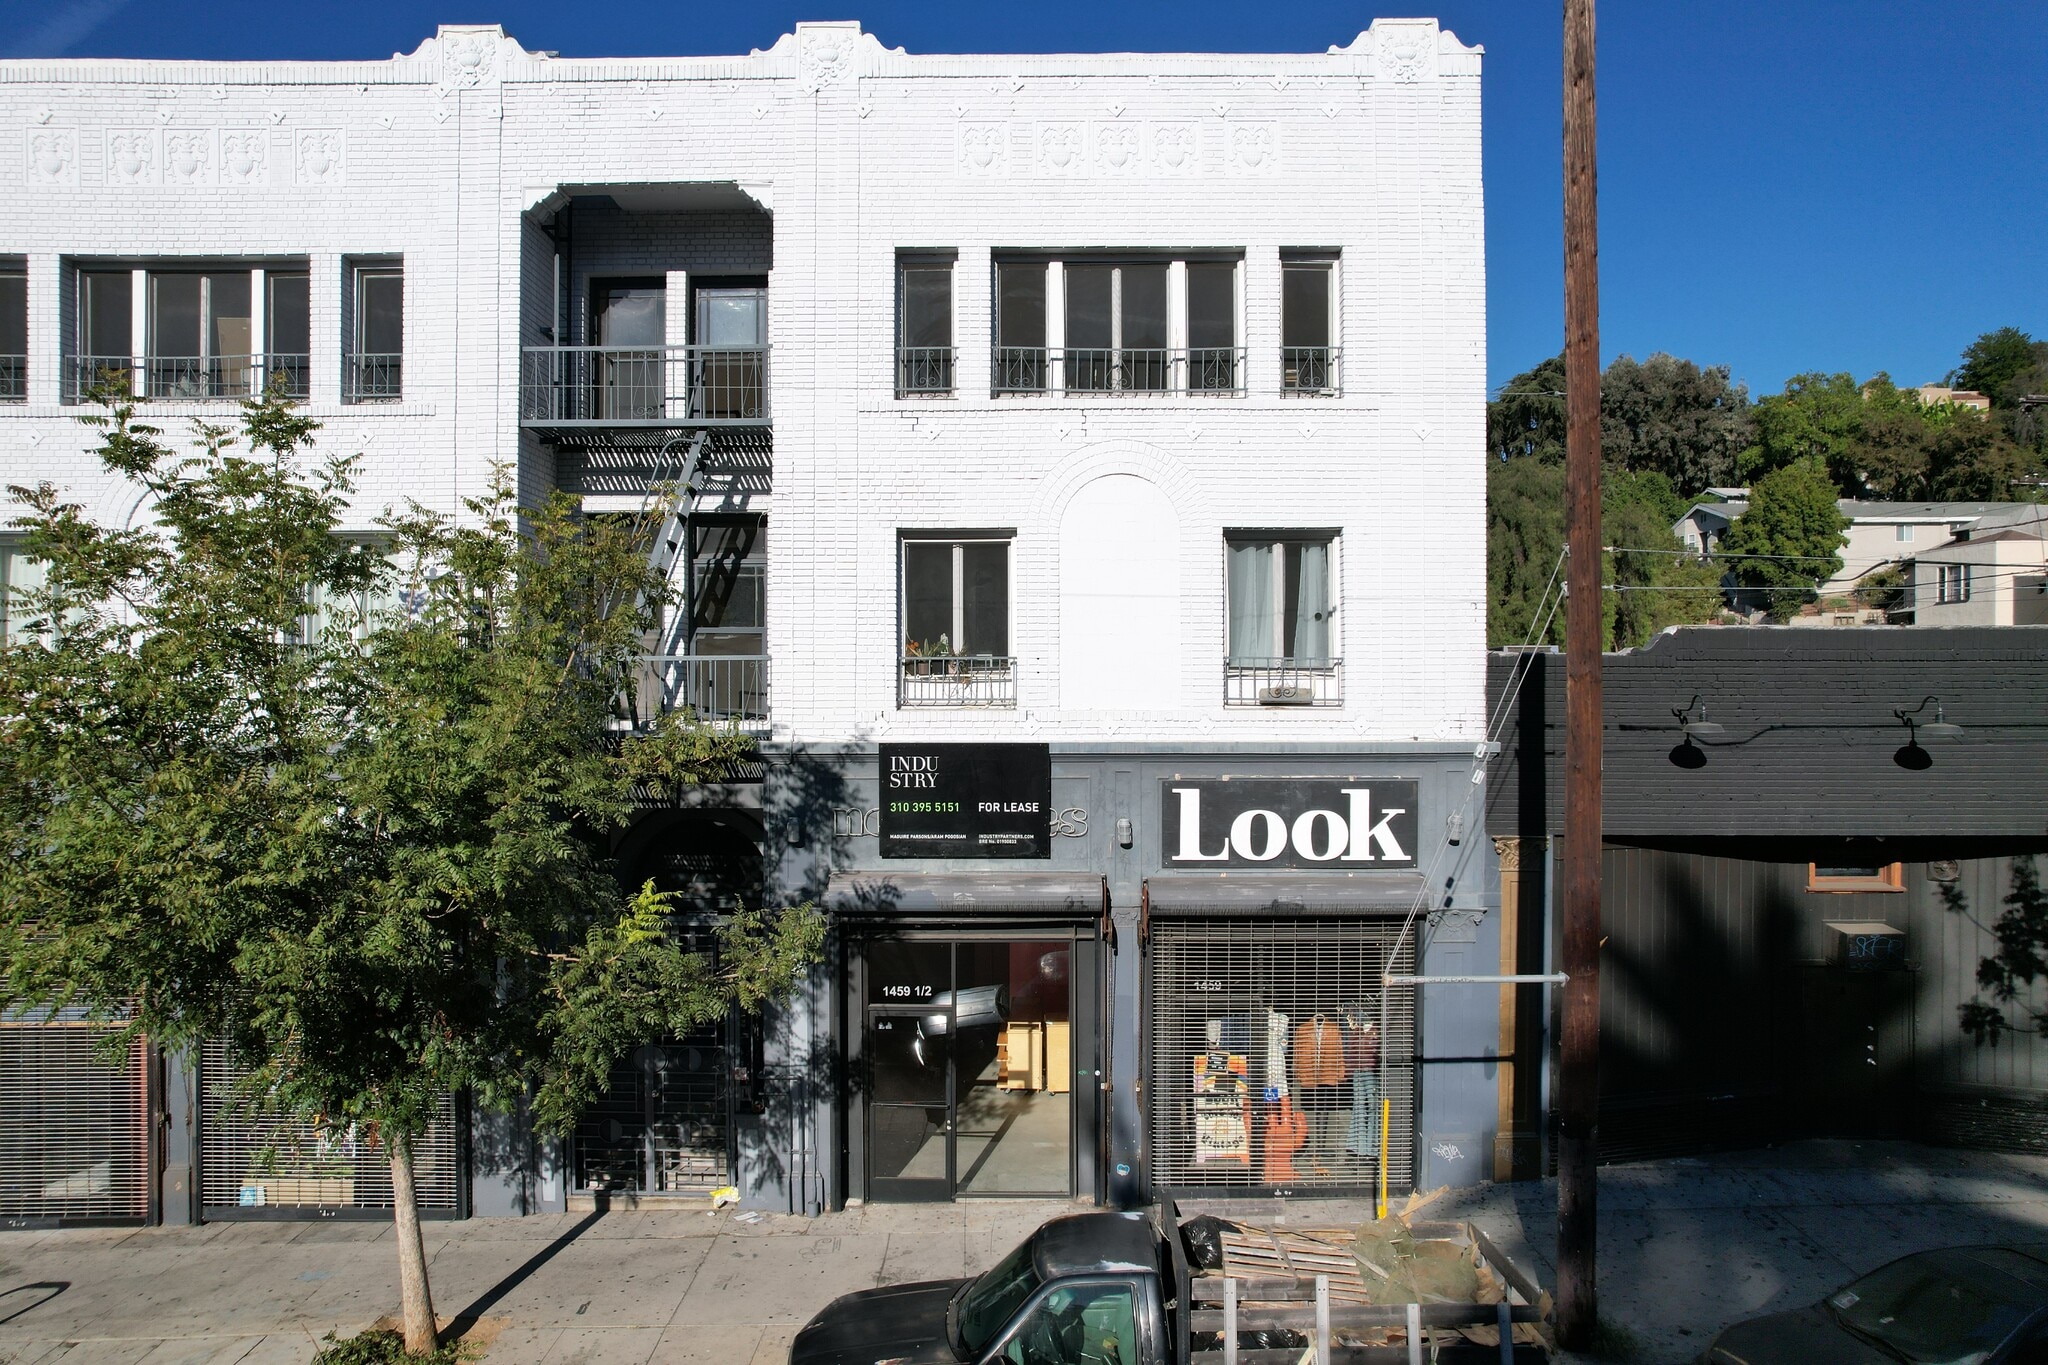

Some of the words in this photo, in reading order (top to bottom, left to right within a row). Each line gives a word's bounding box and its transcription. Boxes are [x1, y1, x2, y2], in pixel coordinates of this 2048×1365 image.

[890, 756, 940, 772] INDU
[889, 773, 940, 788] STRY
[890, 802, 910, 813] 310
[912, 802, 932, 813] 395
[935, 802, 960, 813] 5151
[978, 802, 1000, 813] FOR
[1004, 802, 1040, 813] LEASE
[1172, 788, 1412, 861] Look
[882, 985, 911, 997] 1459
[914, 985, 932, 997] 1/2
